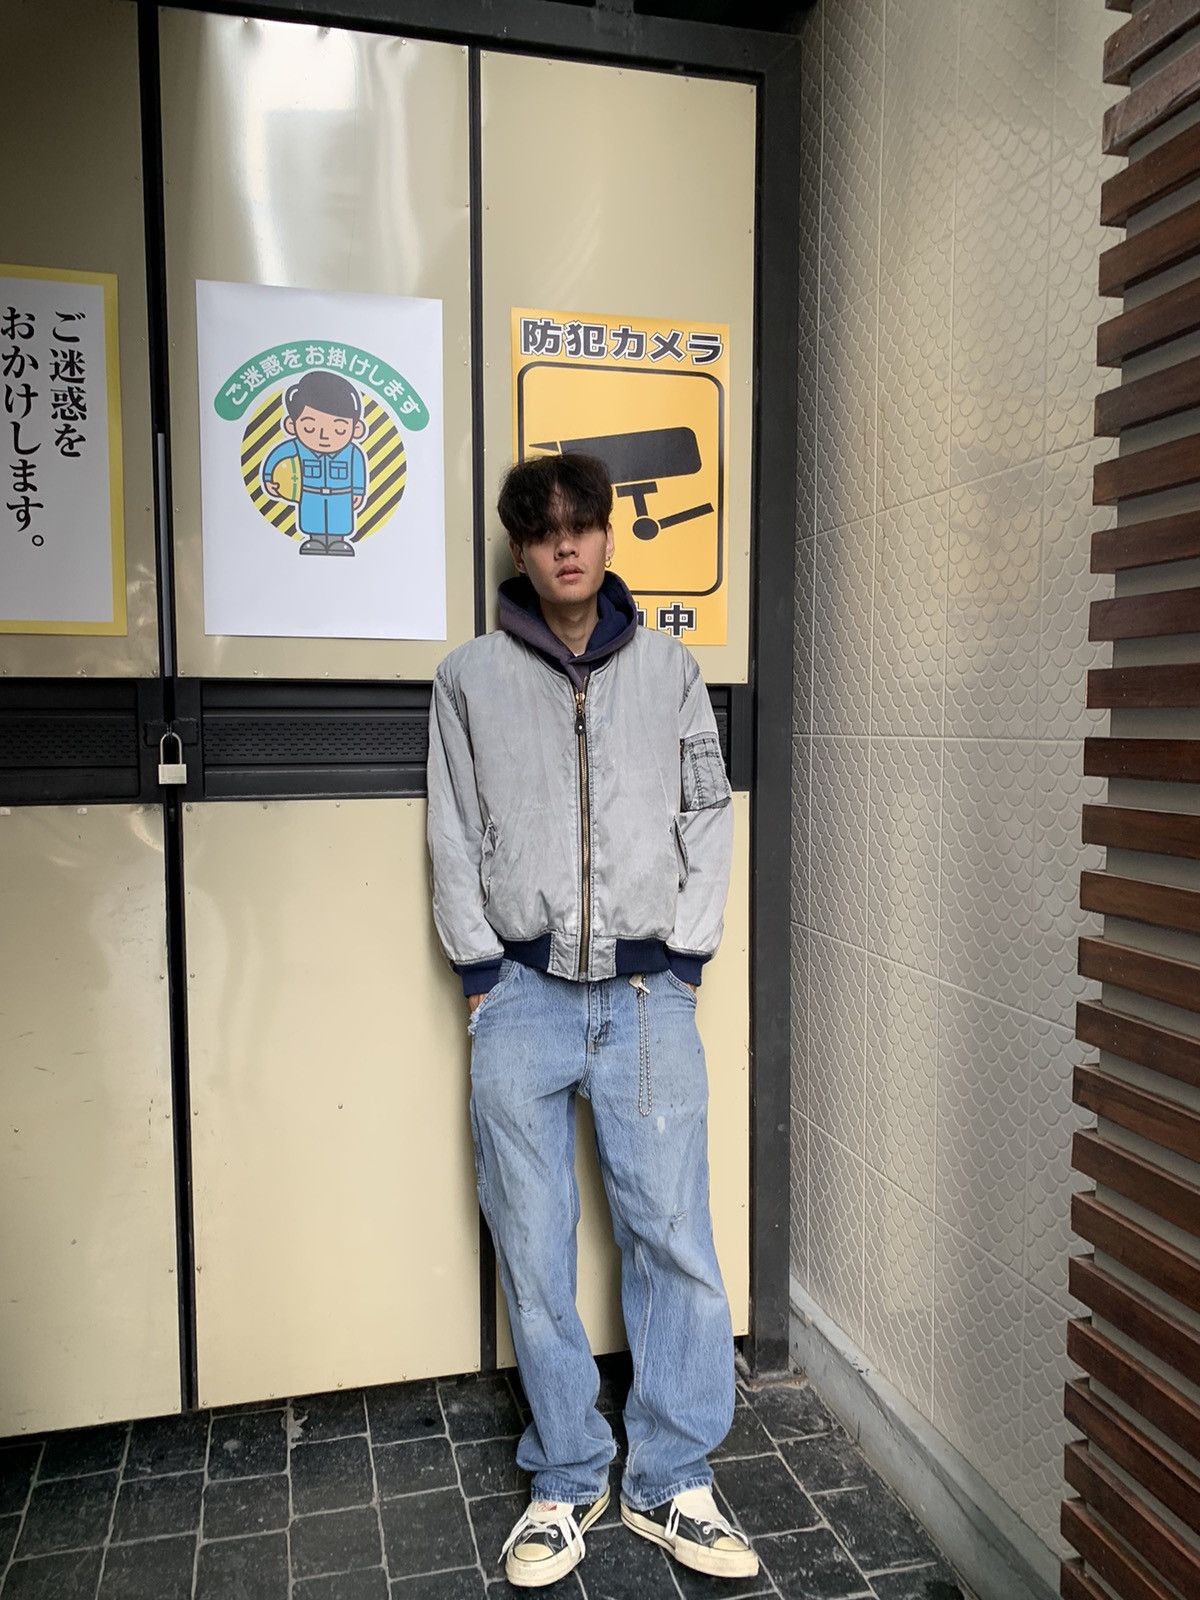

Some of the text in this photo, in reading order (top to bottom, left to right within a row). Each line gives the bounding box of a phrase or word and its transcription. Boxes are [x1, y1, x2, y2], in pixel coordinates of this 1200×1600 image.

[520, 317, 723, 365] 防犯カメラ
[49, 310, 88, 458] ご迷惑を
[224, 344, 421, 415] ご迷惑をお掛けします
[0, 306, 45, 547] おかけします。
[635, 601, 697, 638] 中
